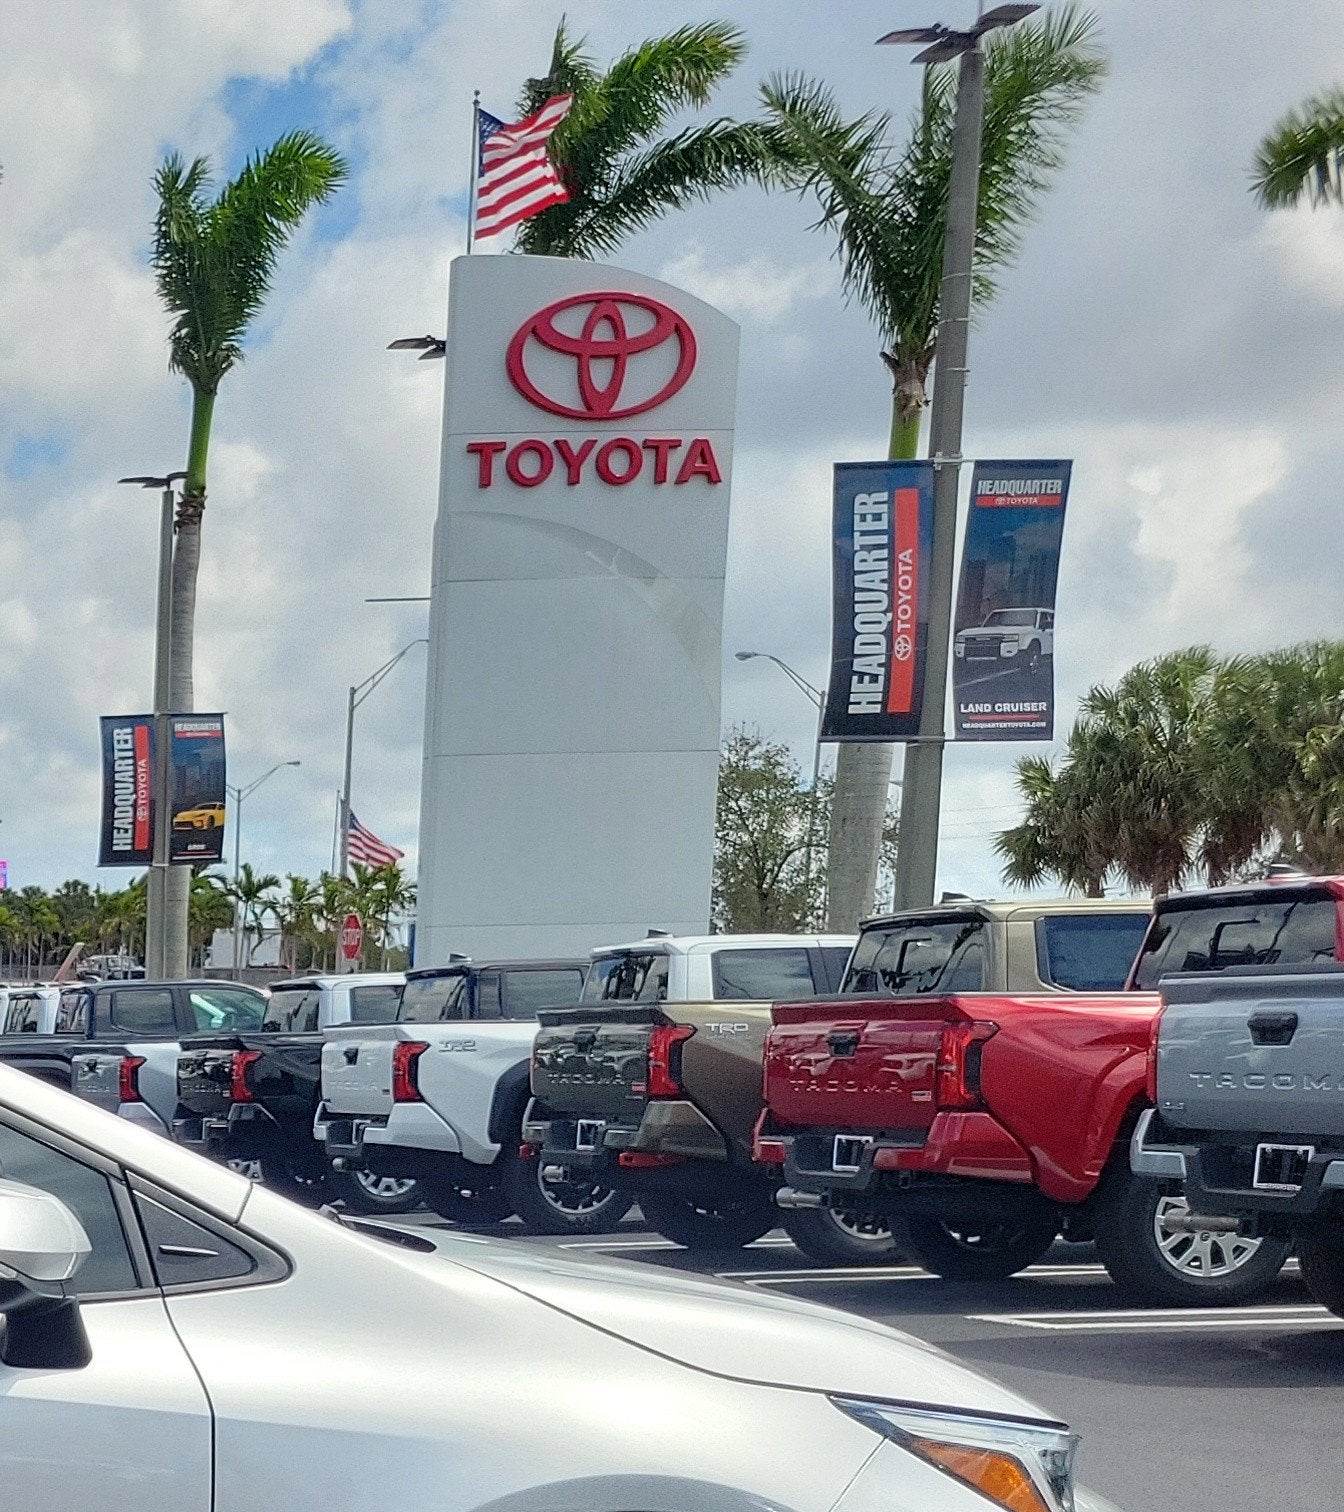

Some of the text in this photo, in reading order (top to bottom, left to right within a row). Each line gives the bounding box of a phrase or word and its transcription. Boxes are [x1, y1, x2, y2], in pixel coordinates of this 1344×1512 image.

[466, 437, 722, 489] TOYOTA
[977, 479, 1062, 495] HEADQUARTER
[848, 490, 892, 714] HEADQUARTER
[897, 548, 914, 633] TOYOTA
[960, 702, 1047, 713] LAND CRUISER
[113, 727, 136, 851] HEADQUARTER
[137, 759, 148, 806] TOYOTA
[343, 928, 361, 946] STOP
[789, 1080, 903, 1093] TACOMA
[1188, 1072, 1344, 1092] TACOM
